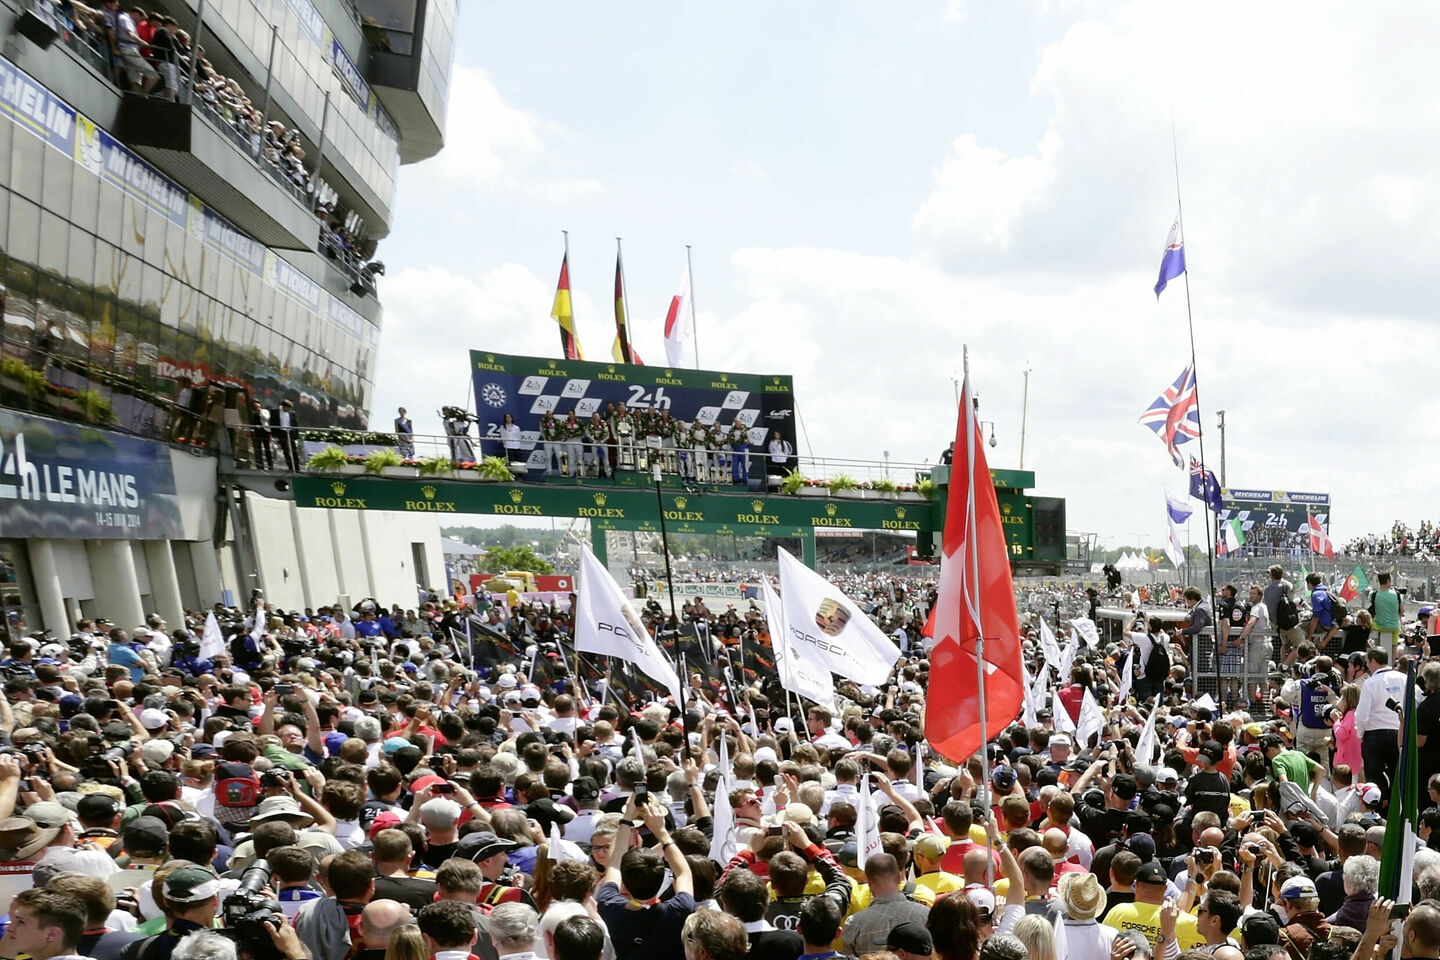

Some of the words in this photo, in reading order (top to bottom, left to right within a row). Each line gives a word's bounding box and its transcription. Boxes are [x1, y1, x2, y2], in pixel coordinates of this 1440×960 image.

[0, 66, 72, 140] HELIN
[108, 146, 187, 215] MICHELIN
[478, 362, 505, 372] ROLEX
[538, 368, 568, 376] ROLEX
[598, 373, 626, 381] ROLEX
[656, 377, 683, 386] ROLEX
[712, 381, 738, 390] ROLEX
[626, 384, 671, 410] 24h
[0, 432, 41, 501] 4h
[43, 464, 77, 503] LE
[77, 468, 139, 509] MANS
[315, 498, 367, 508] ROLEX
[406, 501, 456, 512] ROLEX
[494, 504, 542, 515] ROLEX
[578, 508, 625, 518] ROLEX
[737, 514, 780, 524] ROLEX
[812, 517, 852, 527] ROLEX
[1000, 515, 1024, 524] OLEX
[1266, 513, 1288, 526] 24h
[882, 520, 920, 530] ROLEX
[1121, 921, 1156, 934] PORSCHE
